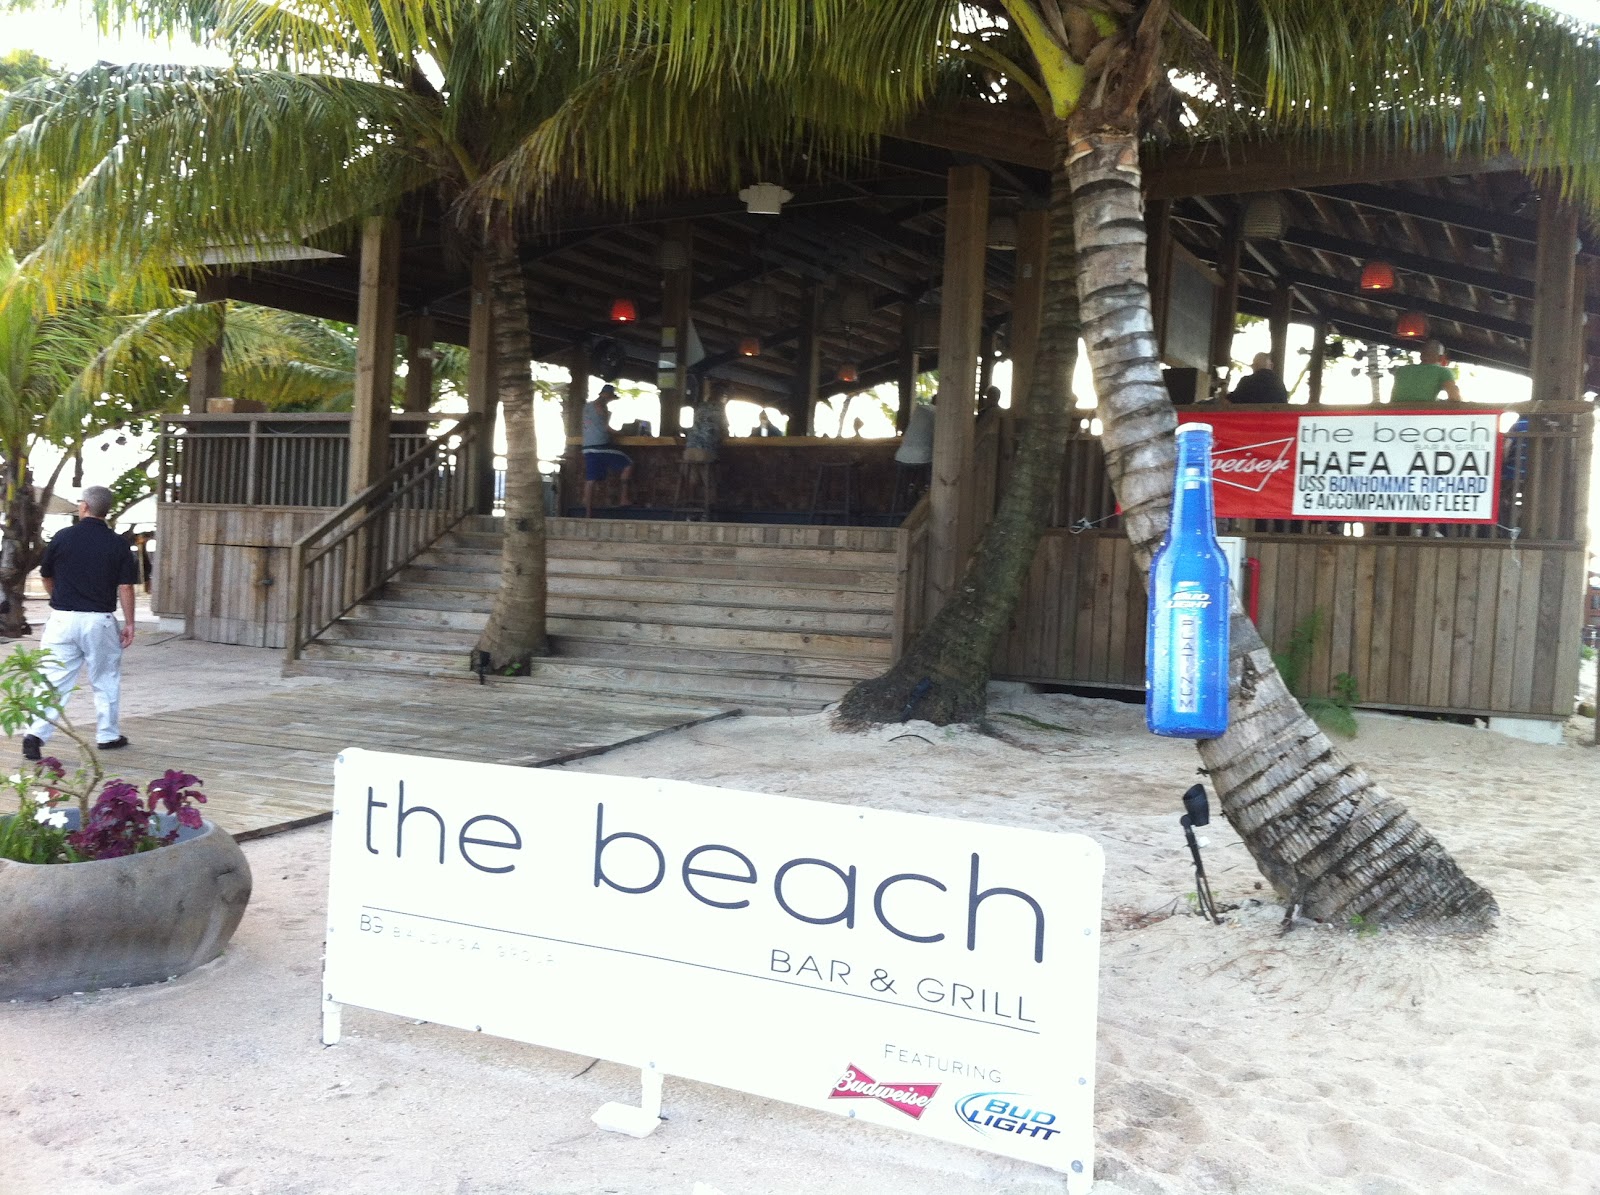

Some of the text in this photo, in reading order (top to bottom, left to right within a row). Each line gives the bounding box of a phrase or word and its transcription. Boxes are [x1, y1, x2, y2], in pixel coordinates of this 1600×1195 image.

[1301, 421, 1490, 443] the beach
[1211, 452, 1290, 473] weiser
[1299, 451, 1490, 476] HAFA ADAI
[1298, 475, 1488, 494] USS BONHOMME RICHARD
[1303, 493, 1480, 512] & ACCOMPANYING FLEET
[1166, 600, 1213, 609] LIGHT
[1172, 591, 1211, 601] BUD
[366, 779, 1046, 964] the beach
[770, 948, 1037, 1024] BAR & GRILL
[883, 1043, 1002, 1084] FEATURING
[984, 1098, 1057, 1126] BUD
[967, 1109, 1062, 1141] LIGHT
